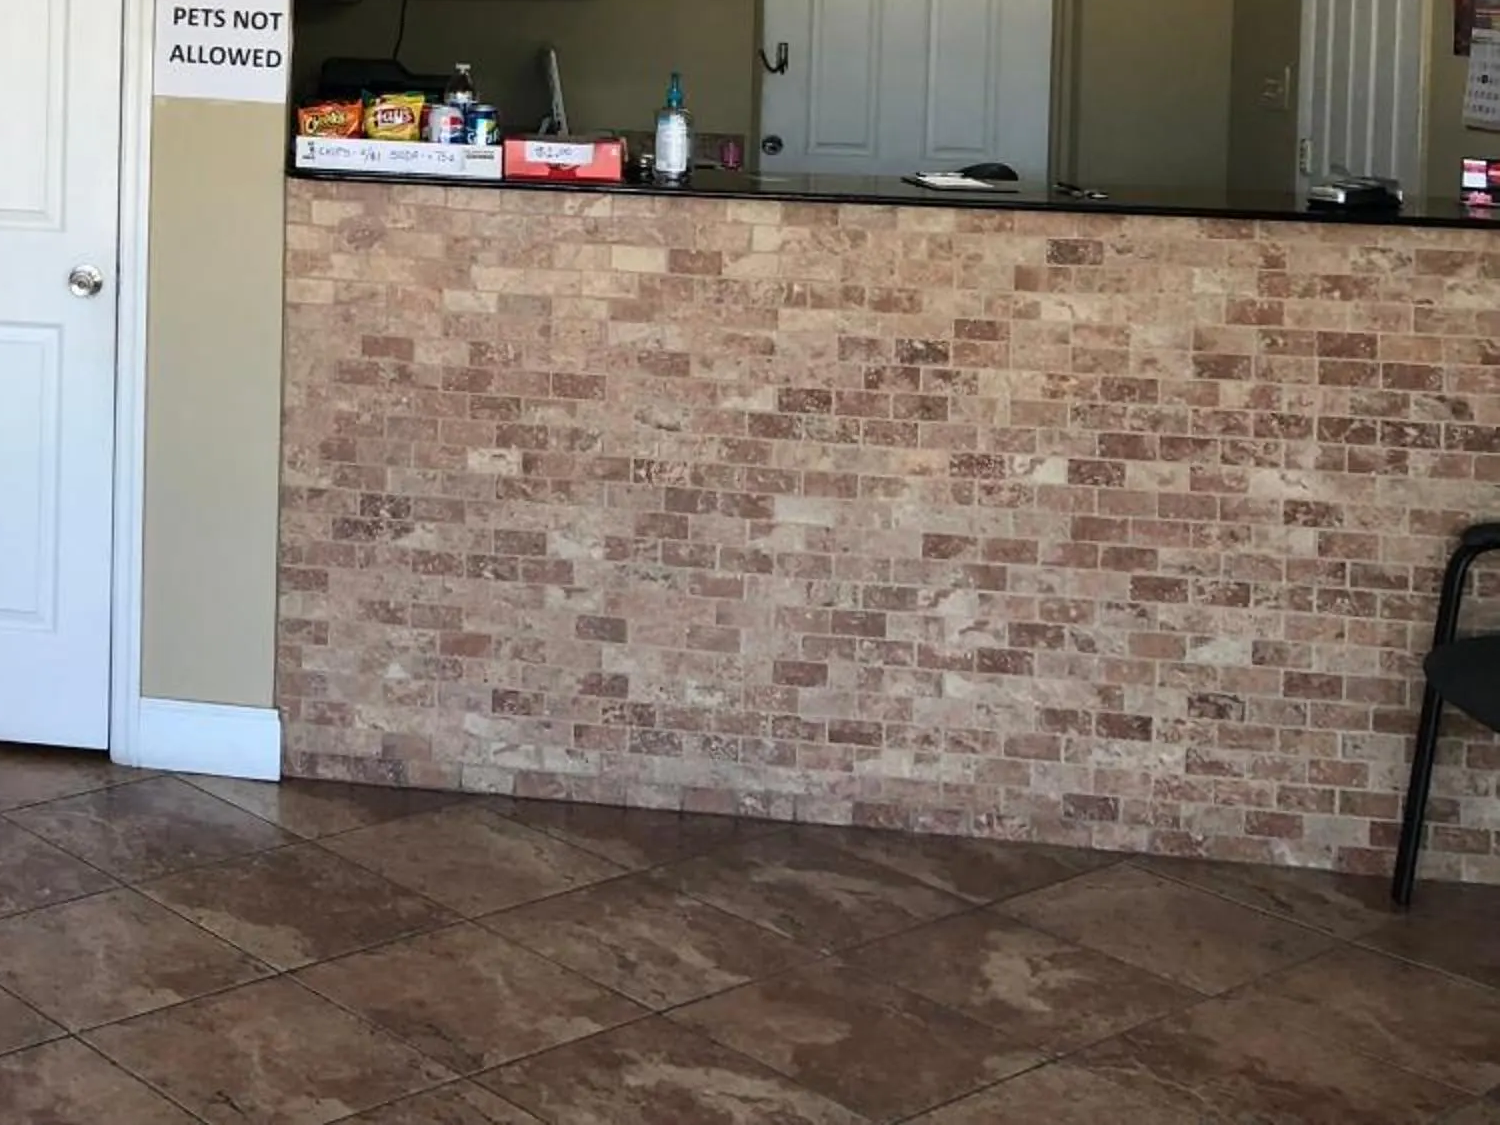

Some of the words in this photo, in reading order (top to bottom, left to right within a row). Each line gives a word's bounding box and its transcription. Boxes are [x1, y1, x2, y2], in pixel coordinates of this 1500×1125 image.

[173, 7, 226, 28] PETS
[233, 10, 283, 31] NOT
[169, 44, 282, 68] ALLOWED
